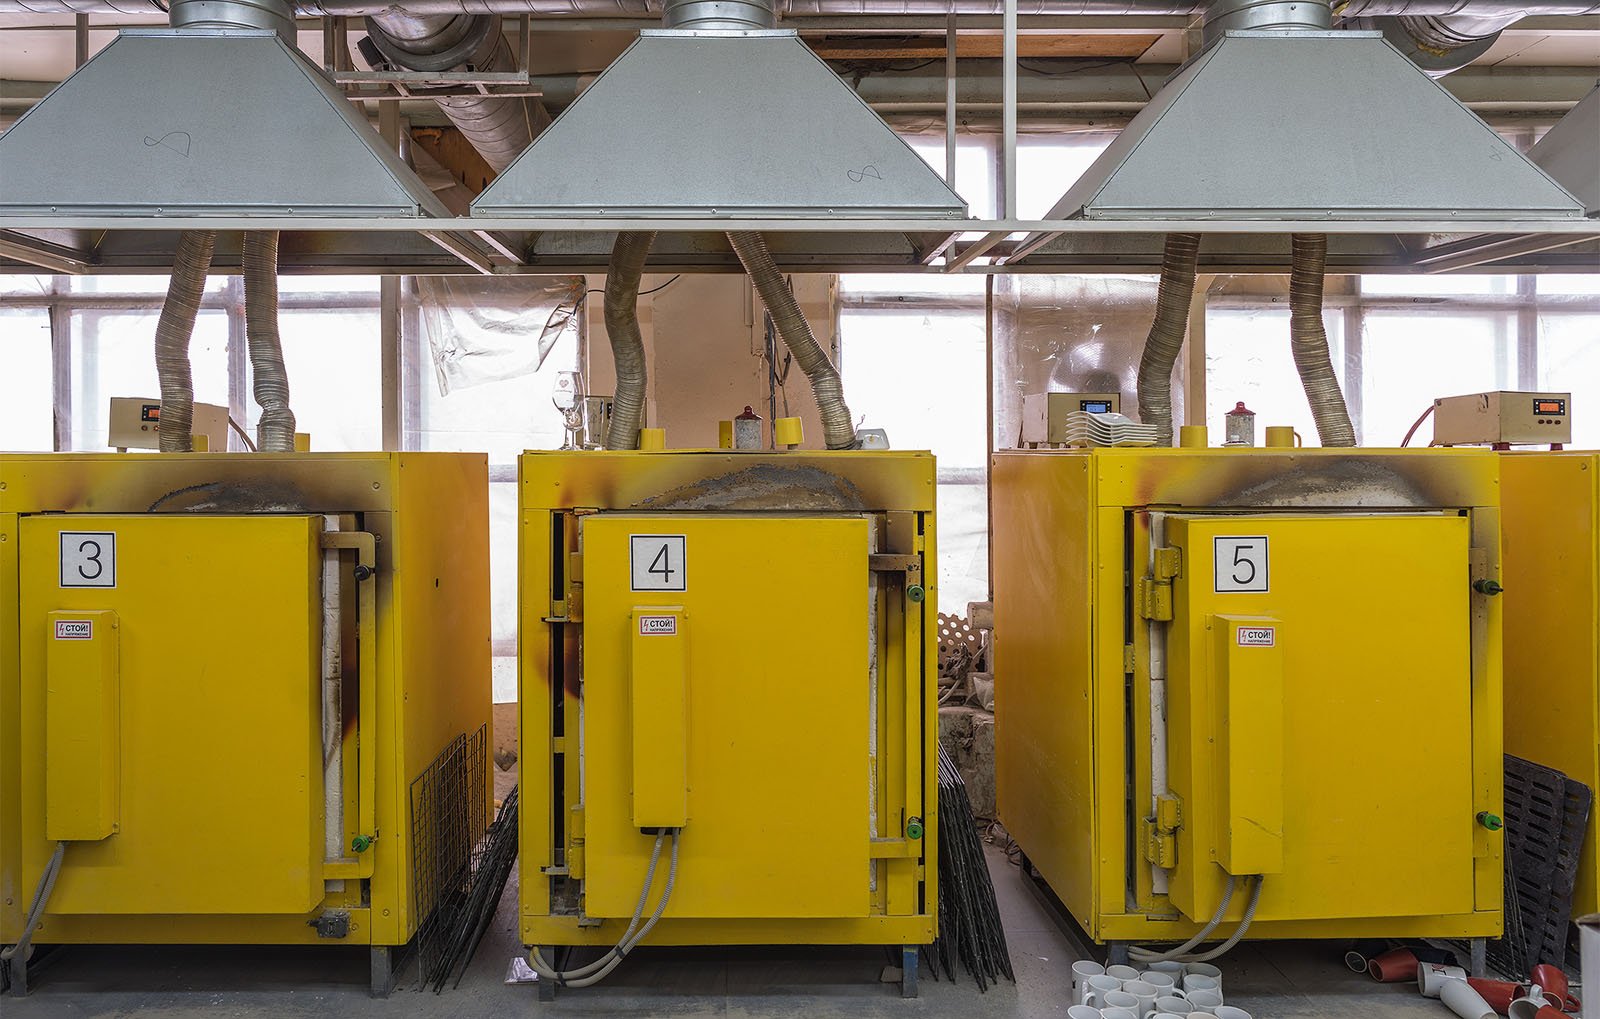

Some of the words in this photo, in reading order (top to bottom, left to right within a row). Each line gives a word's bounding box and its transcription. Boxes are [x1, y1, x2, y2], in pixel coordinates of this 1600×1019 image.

[78, 540, 103, 580] 3
[648, 543, 675, 584] 4
[1232, 545, 1256, 585] 5
[65, 623, 89, 632] СТОЙ!
[650, 619, 673, 628] СТОЙ!
[1248, 630, 1271, 639] СТОЙ!
